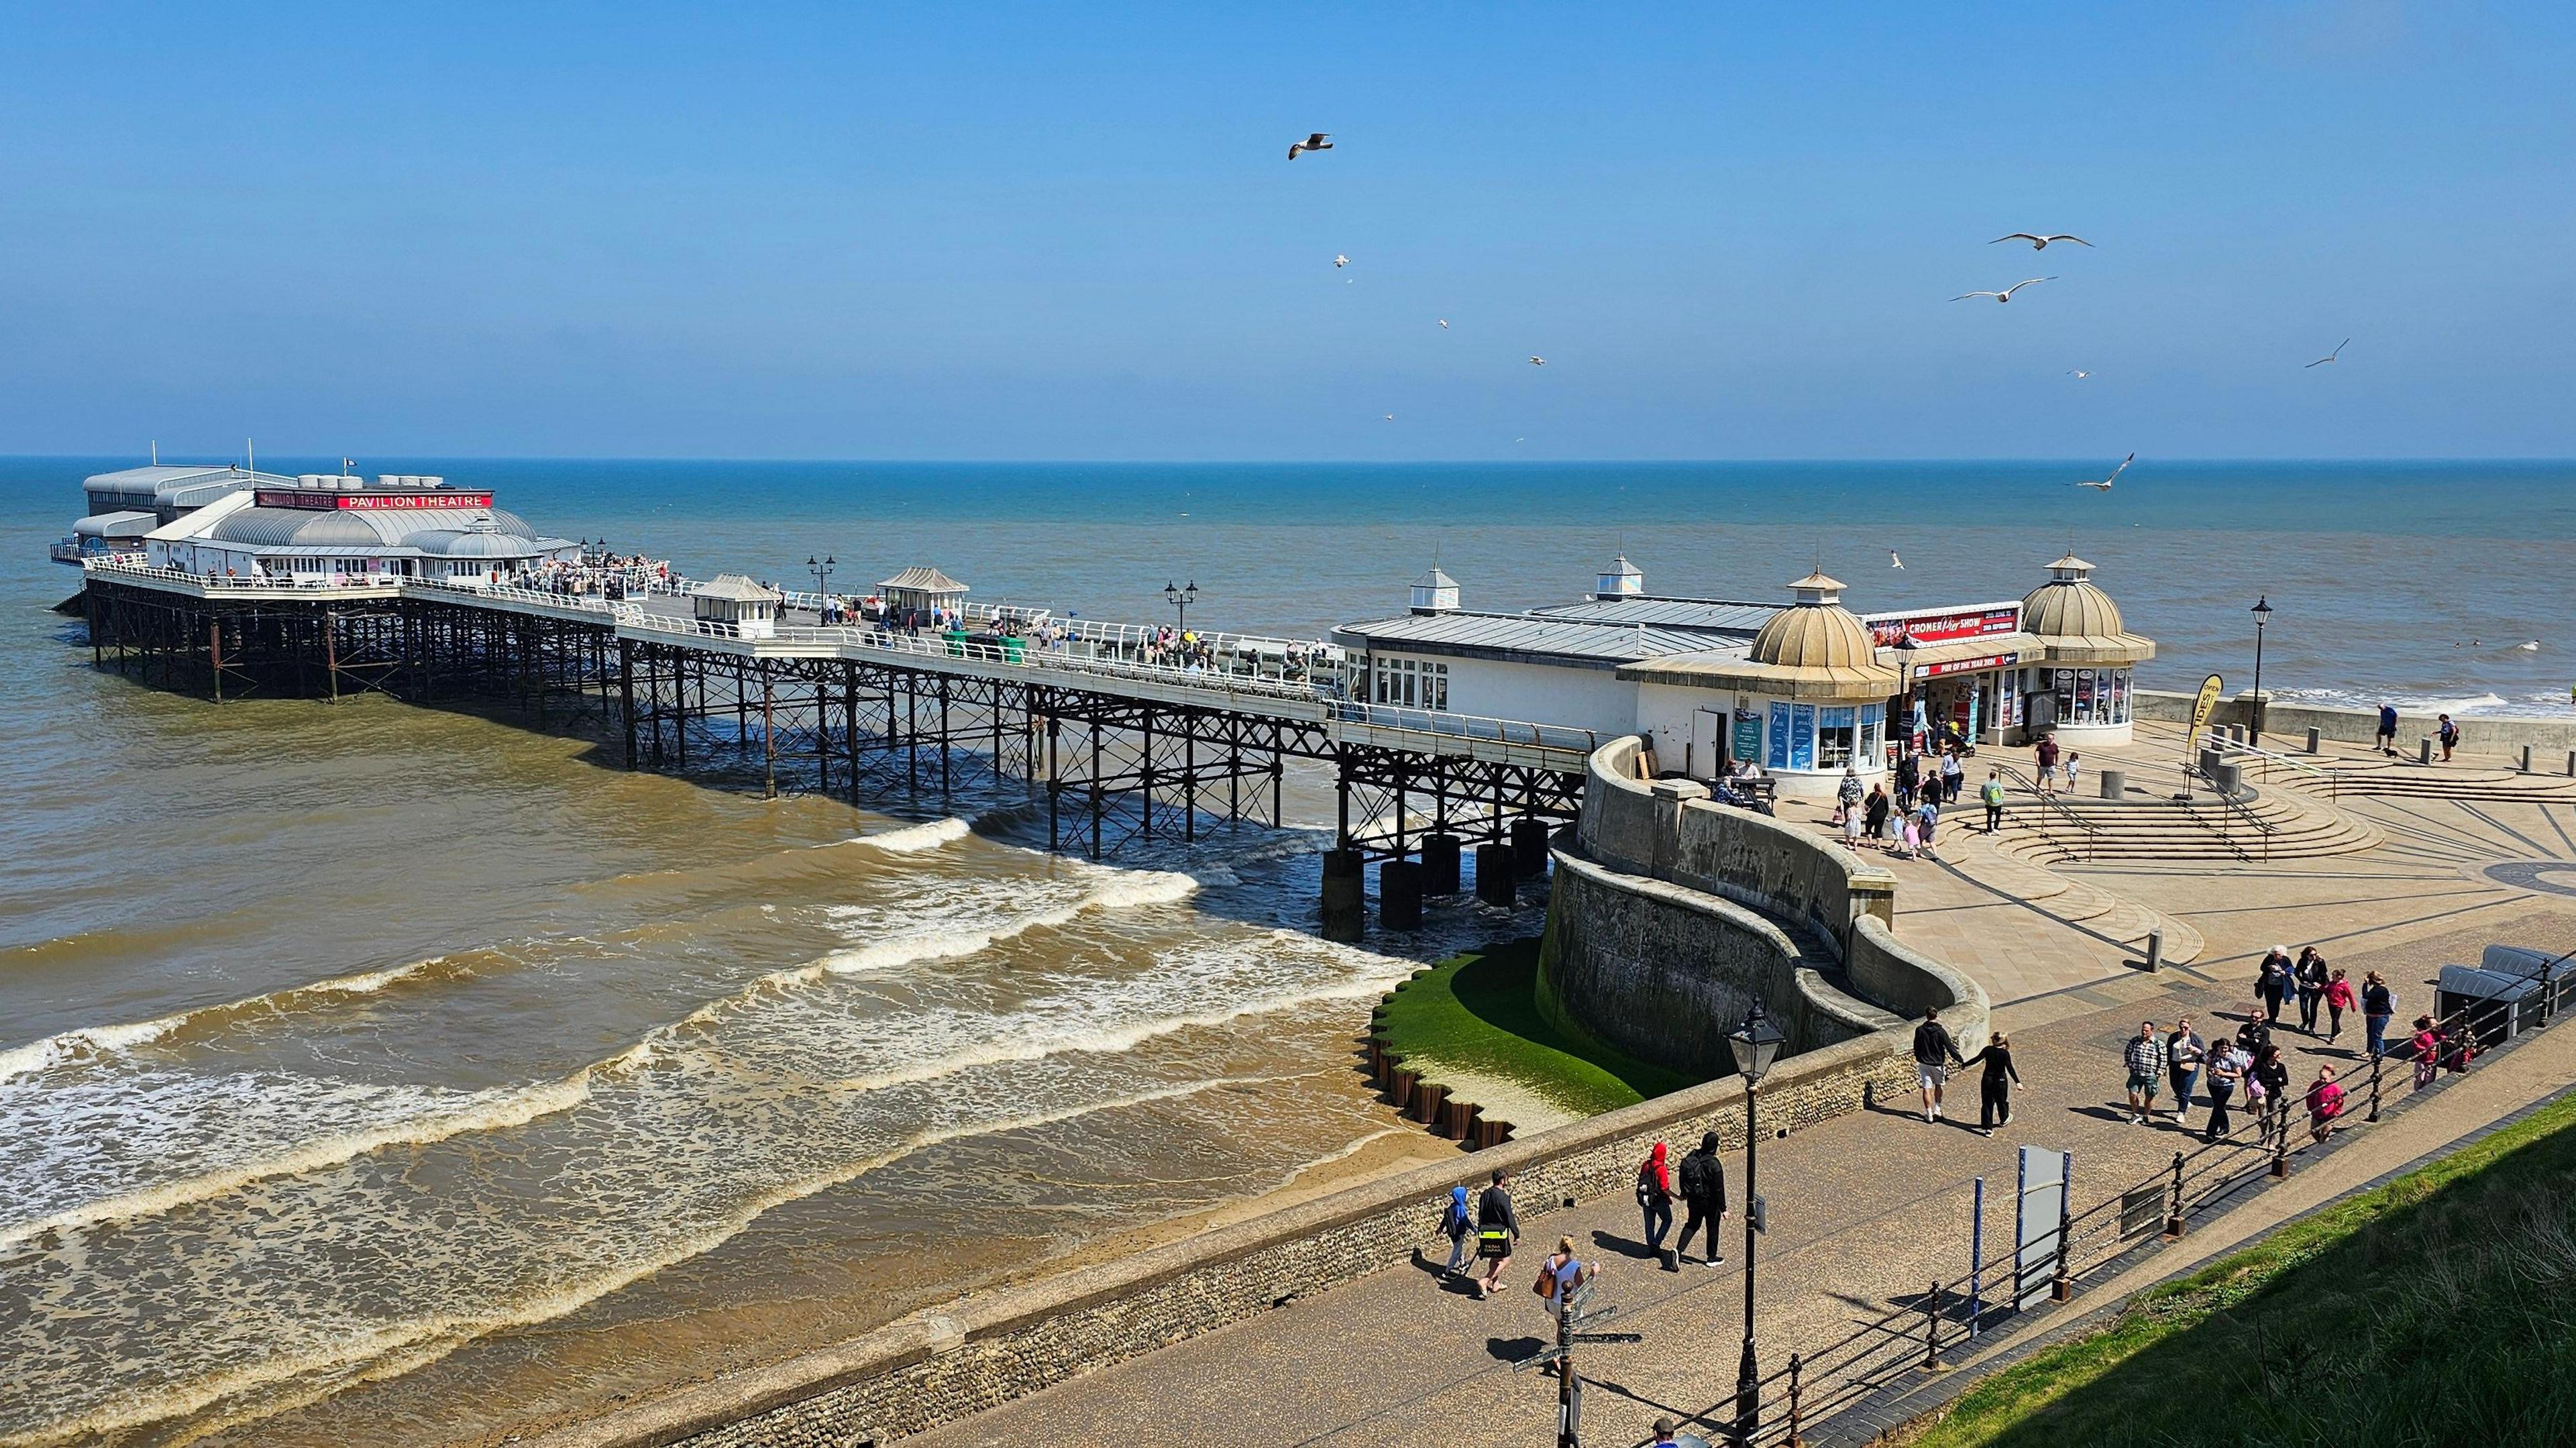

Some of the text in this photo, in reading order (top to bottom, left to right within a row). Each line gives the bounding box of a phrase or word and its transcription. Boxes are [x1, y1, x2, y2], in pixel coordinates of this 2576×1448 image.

[264, 494, 332, 507] PAVILION THEATRE
[349, 496, 482, 508] PAVILION THEATRE
[1909, 616, 1981, 634] CROMER Pier SHOW
[1953, 661, 1960, 671] OF
[2204, 684, 2220, 692] OPEN
